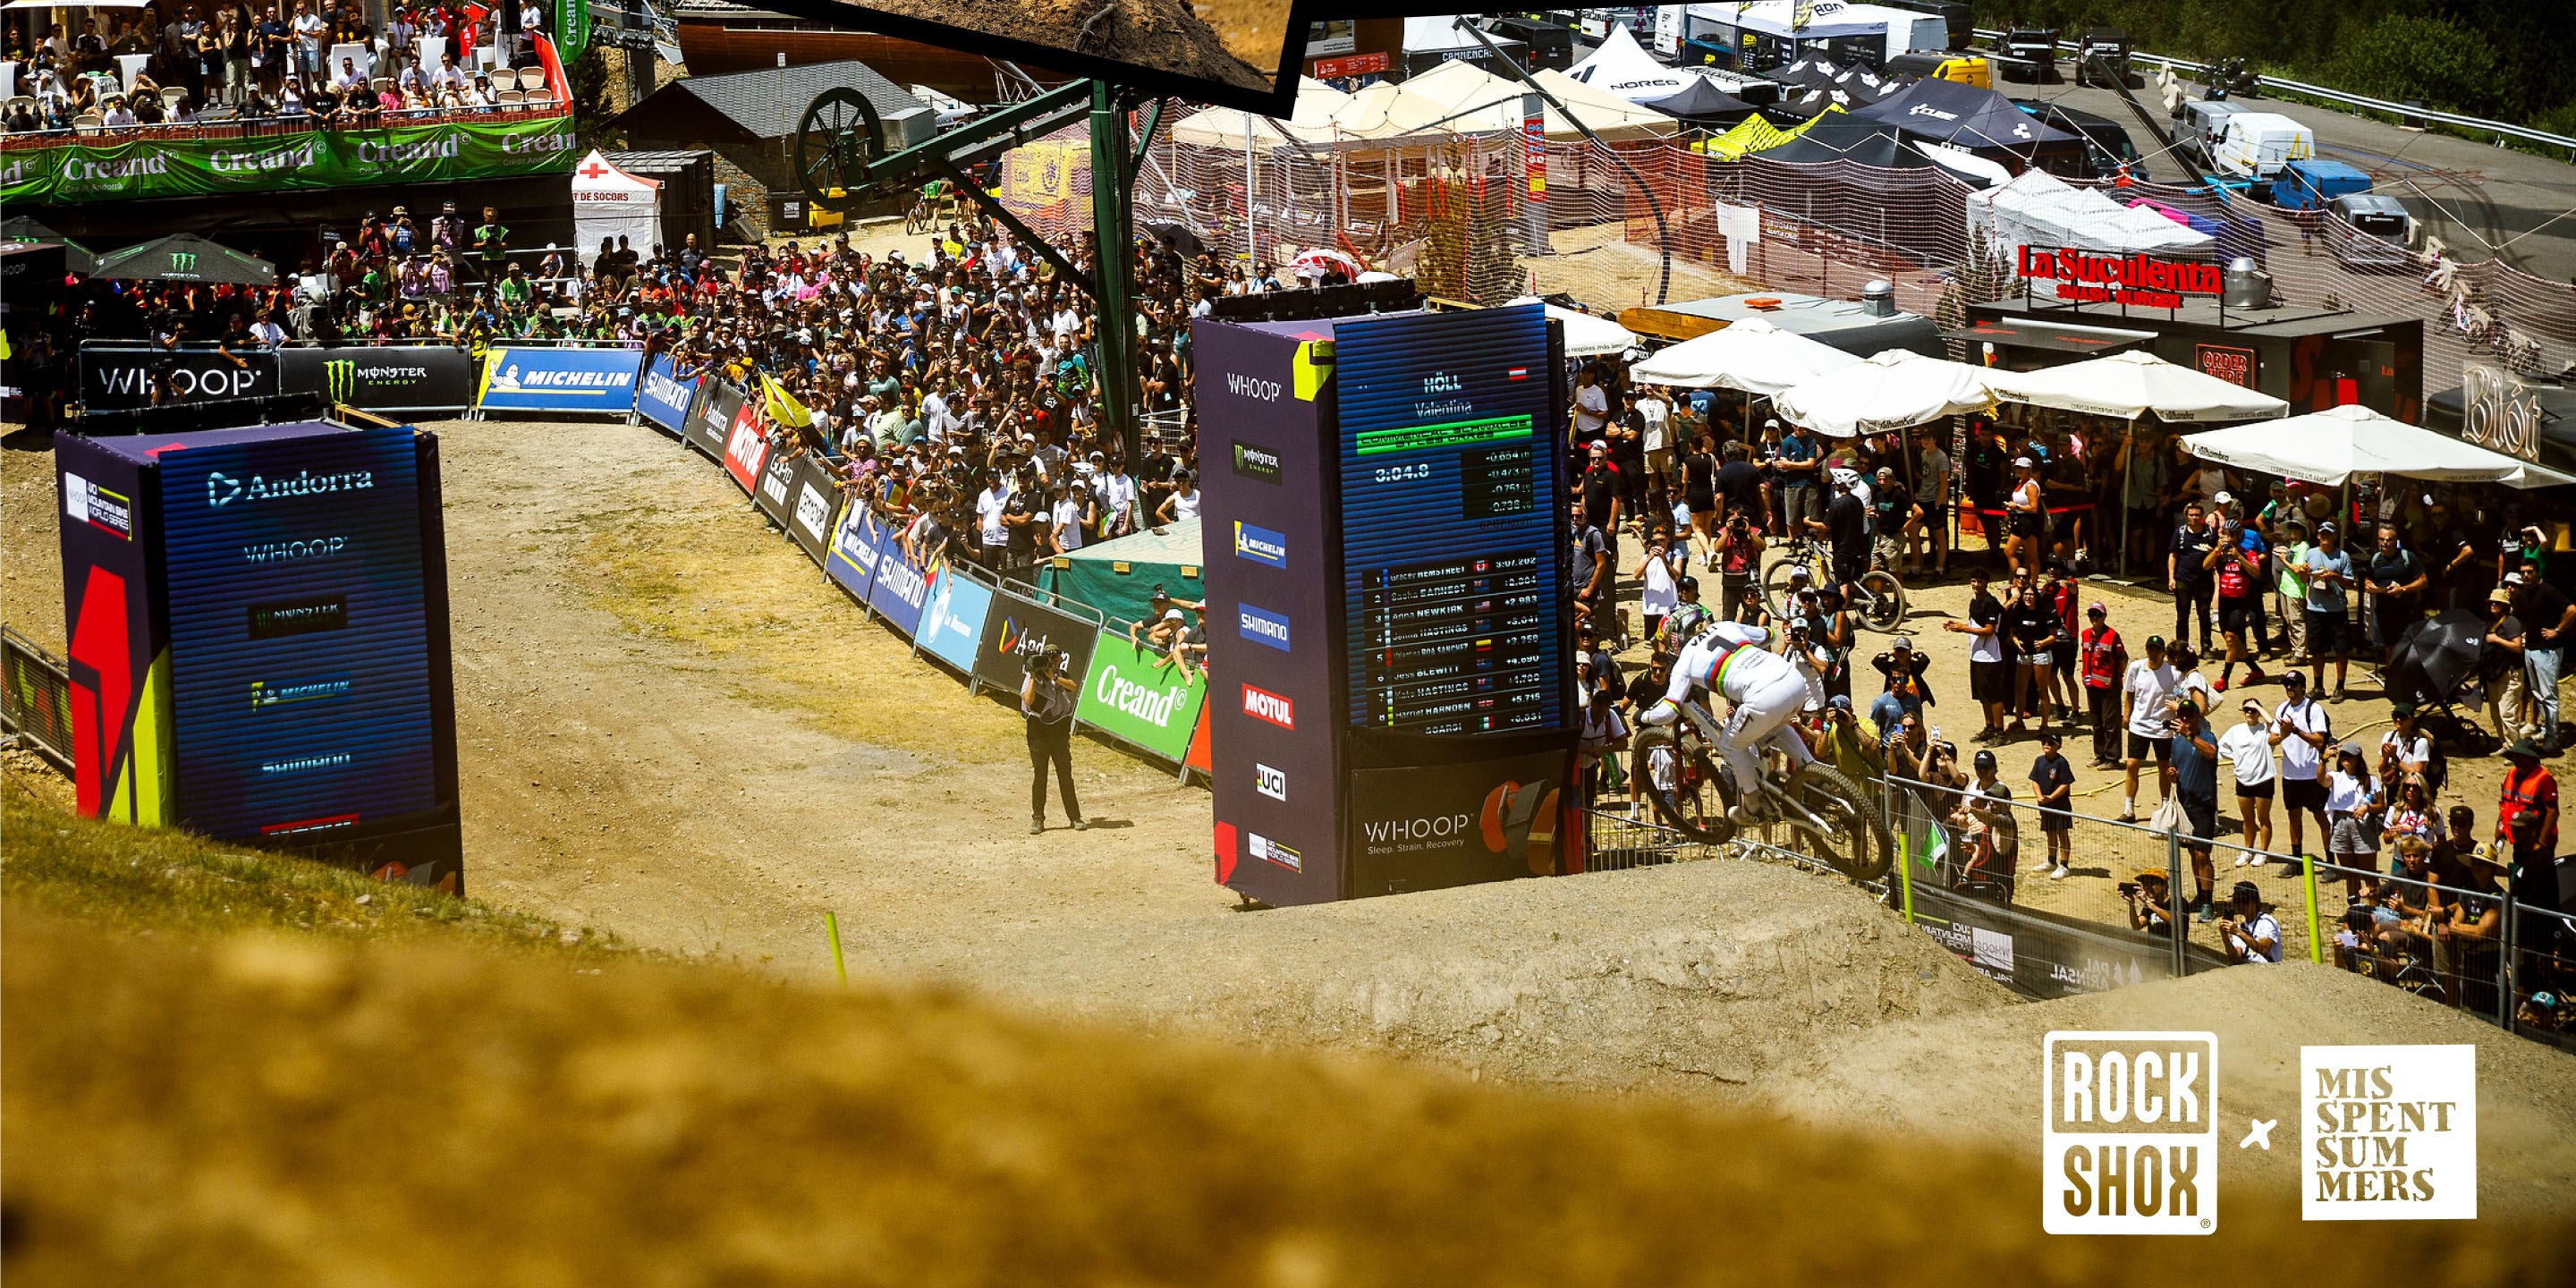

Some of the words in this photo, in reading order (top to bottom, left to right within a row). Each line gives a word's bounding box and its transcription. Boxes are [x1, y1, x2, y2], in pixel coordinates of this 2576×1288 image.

[1610, 79, 1680, 90] NORCO
[580, 192, 592, 201] DE
[594, 192, 629, 201] SOCORS
[2018, 245, 2056, 279] La
[2057, 248, 2224, 294] Suculenta
[2056, 284, 2110, 303] SMASH
[2115, 289, 2184, 309] BURGER
[357, 366, 427, 378] MONSTER
[2203, 351, 2247, 372] ORDER
[523, 370, 631, 387] MICHELIN
[1227, 373, 1281, 402] WHOOP
[1424, 371, 1462, 394] HÖLL
[644, 372, 690, 411] SHIMANO
[1415, 400, 1472, 419] Valentina
[728, 419, 767, 477] MOTUL
[1243, 449, 1279, 468] MONSTER
[1375, 463, 1429, 483] 3:04.8
[246, 469, 374, 501] Andorra
[244, 537, 348, 564] WHOOP
[843, 532, 880, 570] MICHELIN
[1249, 538, 1285, 556] MICHELIN
[877, 555, 926, 609] SHIMANO
[1374, 595, 1381, 603] 2
[1417, 605, 1463, 618] NEWKIRK
[1241, 613, 1288, 641] SHIMANO
[1014, 628, 1070, 671] Andra
[281, 681, 350, 697] MICHELIN
[1245, 689, 1292, 725] MOTUL
[1426, 702, 1471, 716] HARNDEN
[1262, 772, 1284, 795] UCI
[1364, 812, 1474, 843] WHOOP
